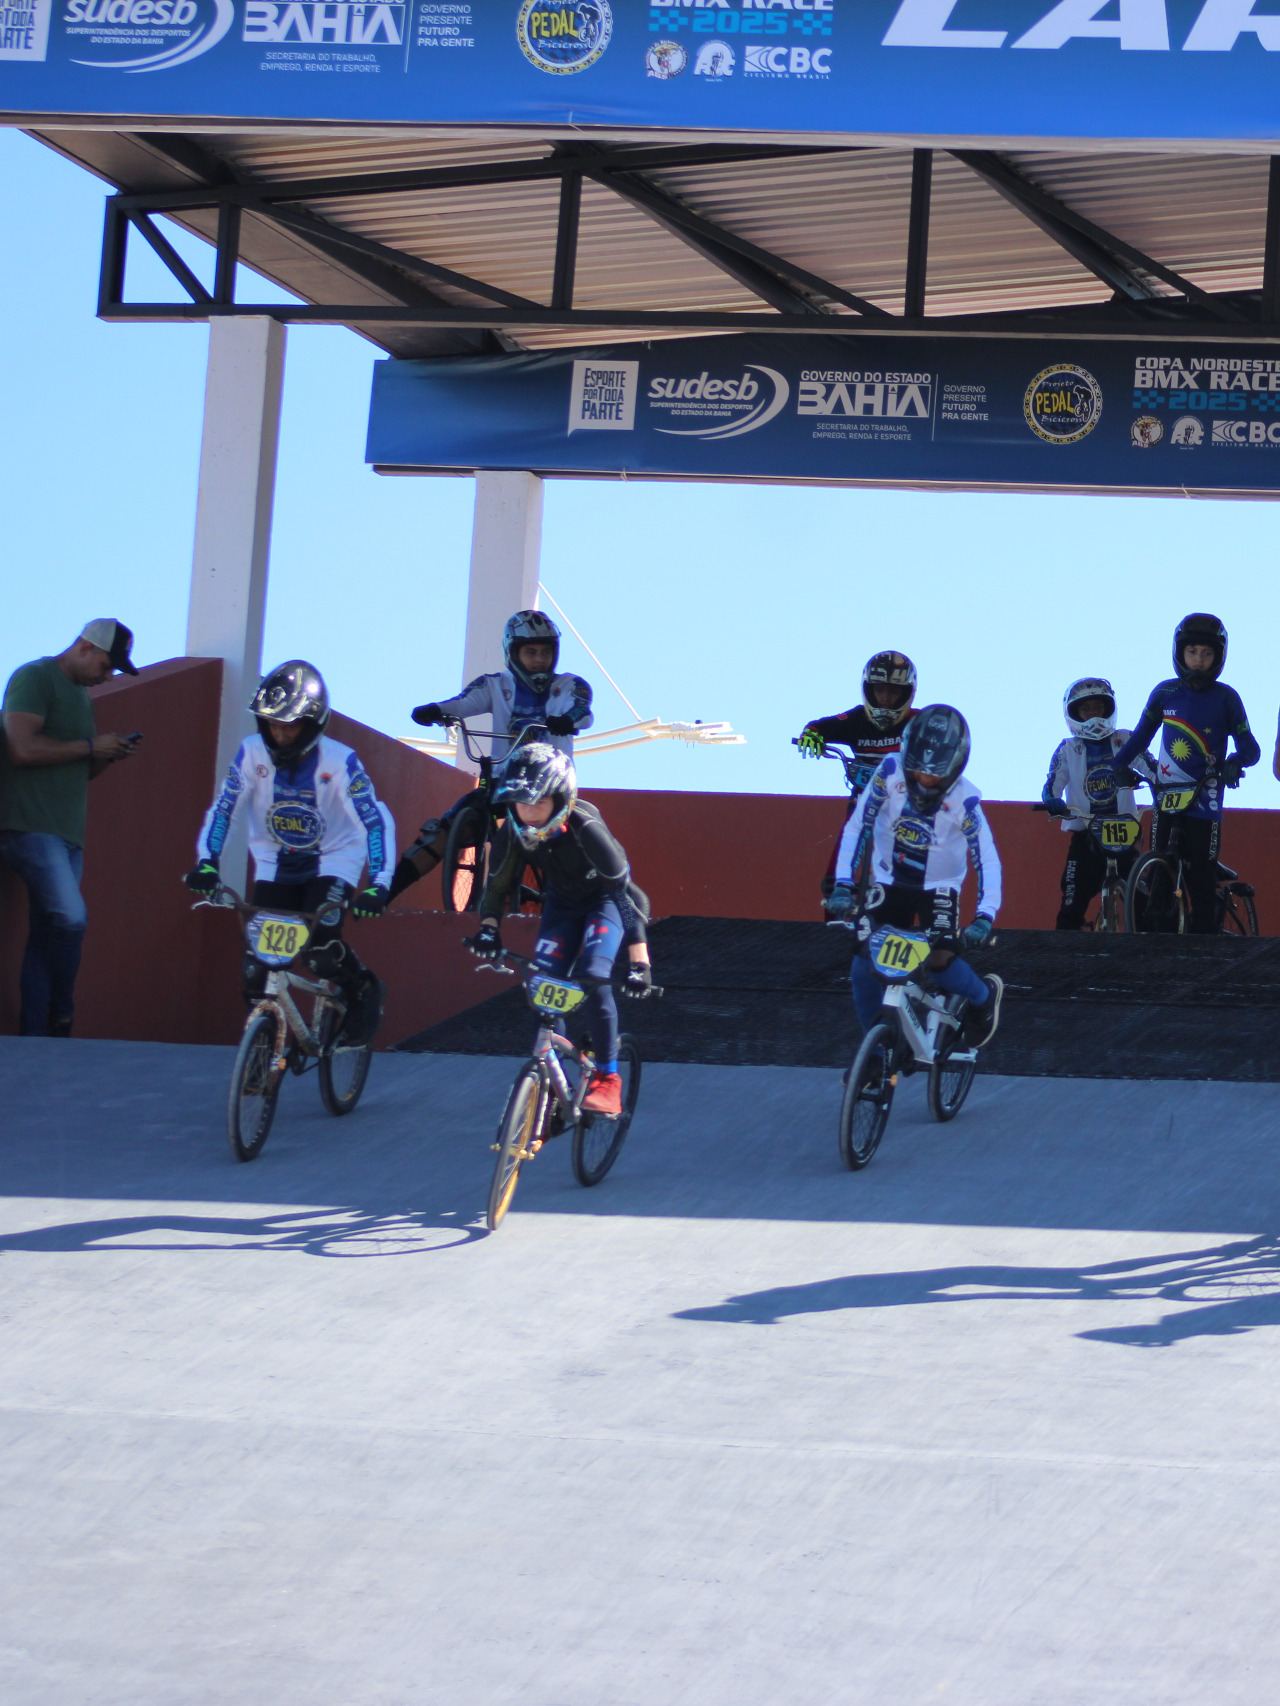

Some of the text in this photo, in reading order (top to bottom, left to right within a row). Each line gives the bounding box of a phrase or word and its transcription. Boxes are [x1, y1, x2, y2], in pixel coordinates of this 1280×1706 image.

[420, 5, 471, 14] GOVERNO
[243, 1, 403, 45] BAHIA
[419, 16, 473, 25] PRESENTE
[531, 9, 580, 39] PEDAL
[692, 10, 788, 34] 2025
[135, 29, 147, 37] DOS
[147, 29, 191, 38] DESPORTOS
[418, 27, 460, 36] FUTURO
[91, 36, 164, 45] DO ESTADO DA BAHIA
[417, 38, 475, 47] PRA GENTE
[265, 52, 377, 62] SECRETARIA DO TRABALHO,
[766, 47, 833, 73] CBC
[260, 63, 303, 72] EMPREGO,
[305, 64, 334, 72] RENDA
[342, 65, 381, 73] ESPORTE
[1135, 357, 1184, 370] COPA
[584, 367, 627, 388] ESPORTE
[800, 371, 931, 384] GOVERNO DO ESTADO
[1133, 370, 1200, 390] BMX
[647, 371, 759, 401] sudesb
[943, 385, 986, 393] GOVERNO
[797, 381, 930, 418] BAHIA
[942, 394, 987, 402] PRESENTE
[1036, 390, 1075, 414] PEDAL
[1167, 391, 1248, 411] 2025
[581, 401, 624, 420] PARTE
[720, 402, 754, 410] DESPORTOS
[942, 403, 977, 411] FUTURO
[941, 412, 989, 421] PRA GENTE
[816, 422, 858, 431] SECRETARIA
[870, 424, 909, 433] TRABALHO,
[812, 432, 847, 441] EMPREGO,
[848, 432, 873, 440] RENDA
[880, 433, 912, 441] ESPORTE
[1164, 792, 1182, 808] 87
[1103, 823, 1127, 843] 115
[267, 924, 298, 953] 128
[884, 939, 914, 968] 114
[543, 984, 569, 1009] 93
